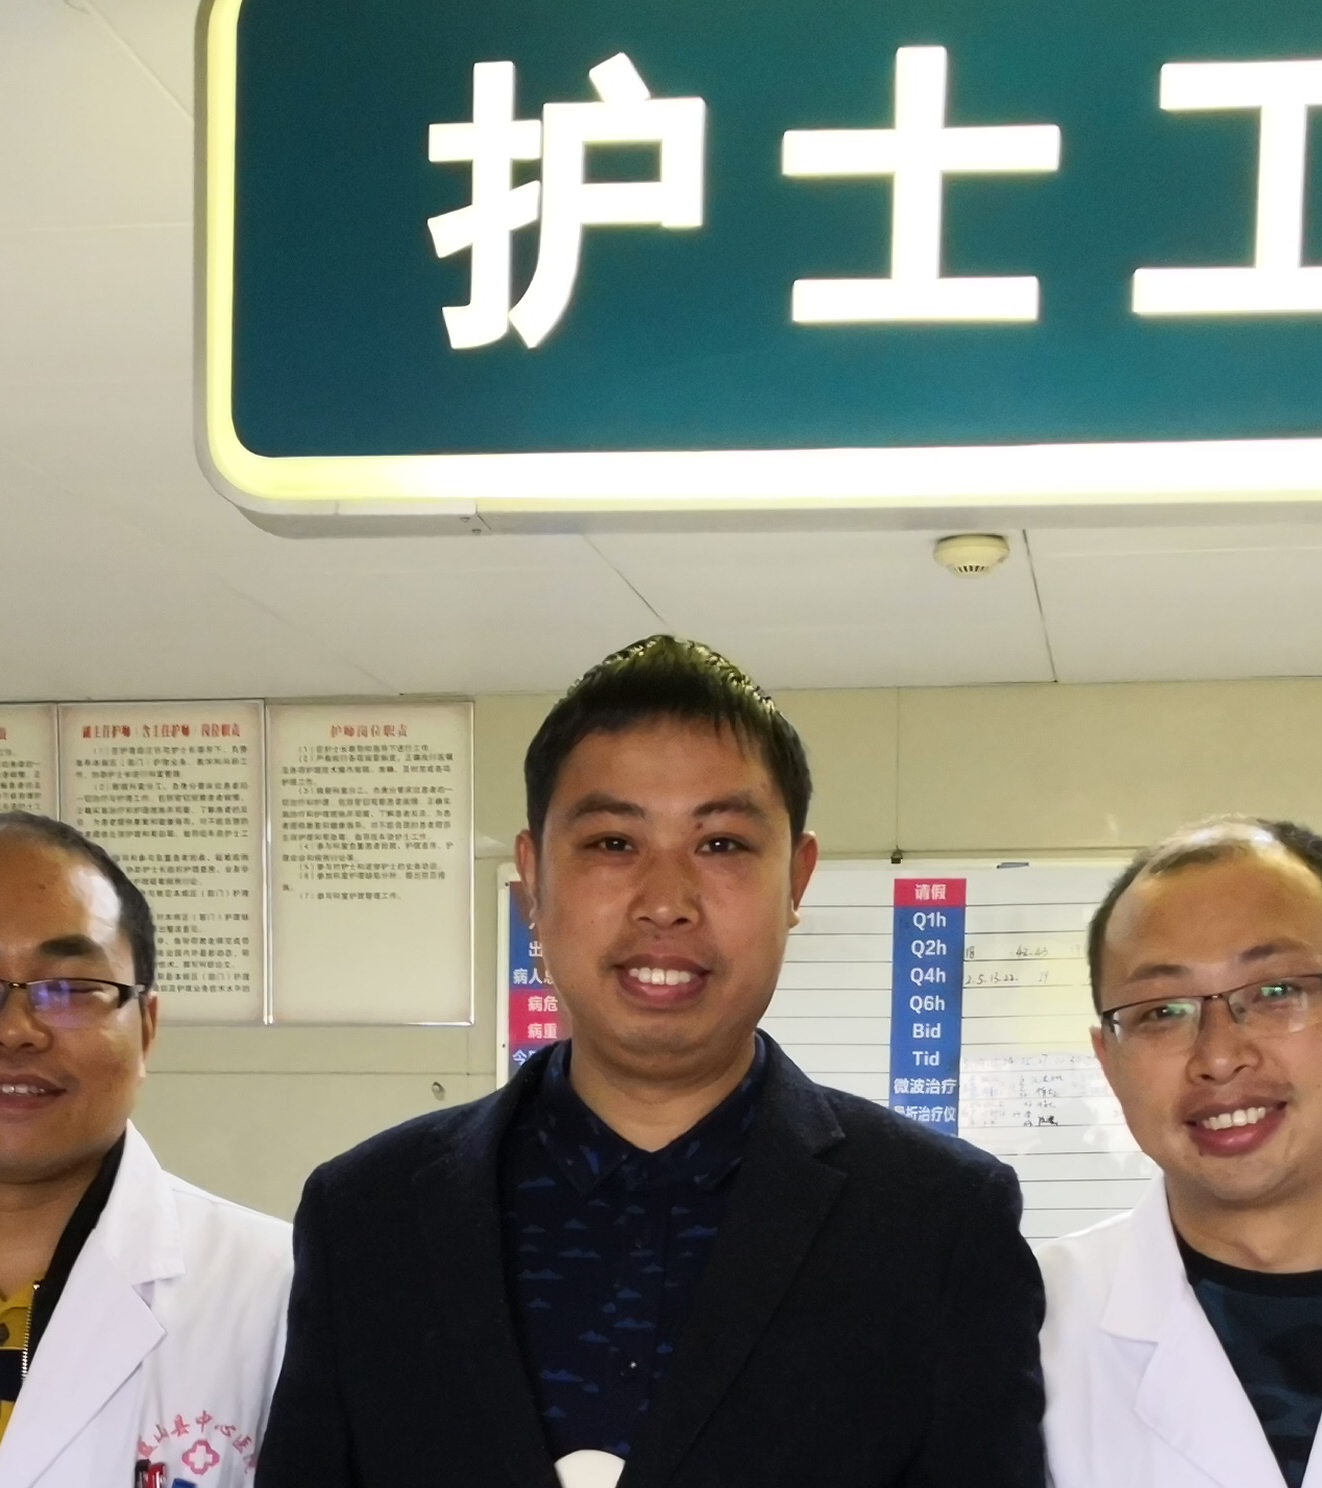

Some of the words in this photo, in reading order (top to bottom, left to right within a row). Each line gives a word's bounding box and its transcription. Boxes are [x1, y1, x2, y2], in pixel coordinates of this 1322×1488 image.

[915, 884, 946, 901] 请假
[913, 912, 946, 929] Q1h
[911, 940, 947, 957] Q2h
[910, 968, 946, 985] Q4h
[528, 996, 558, 1012] 病危
[909, 996, 945, 1012] Q6h
[528, 1023, 557, 1039] 病重
[913, 1023, 941, 1038] Bid
[913, 1051, 940, 1066] Tid
[894, 1078, 957, 1095] 微波治疗
